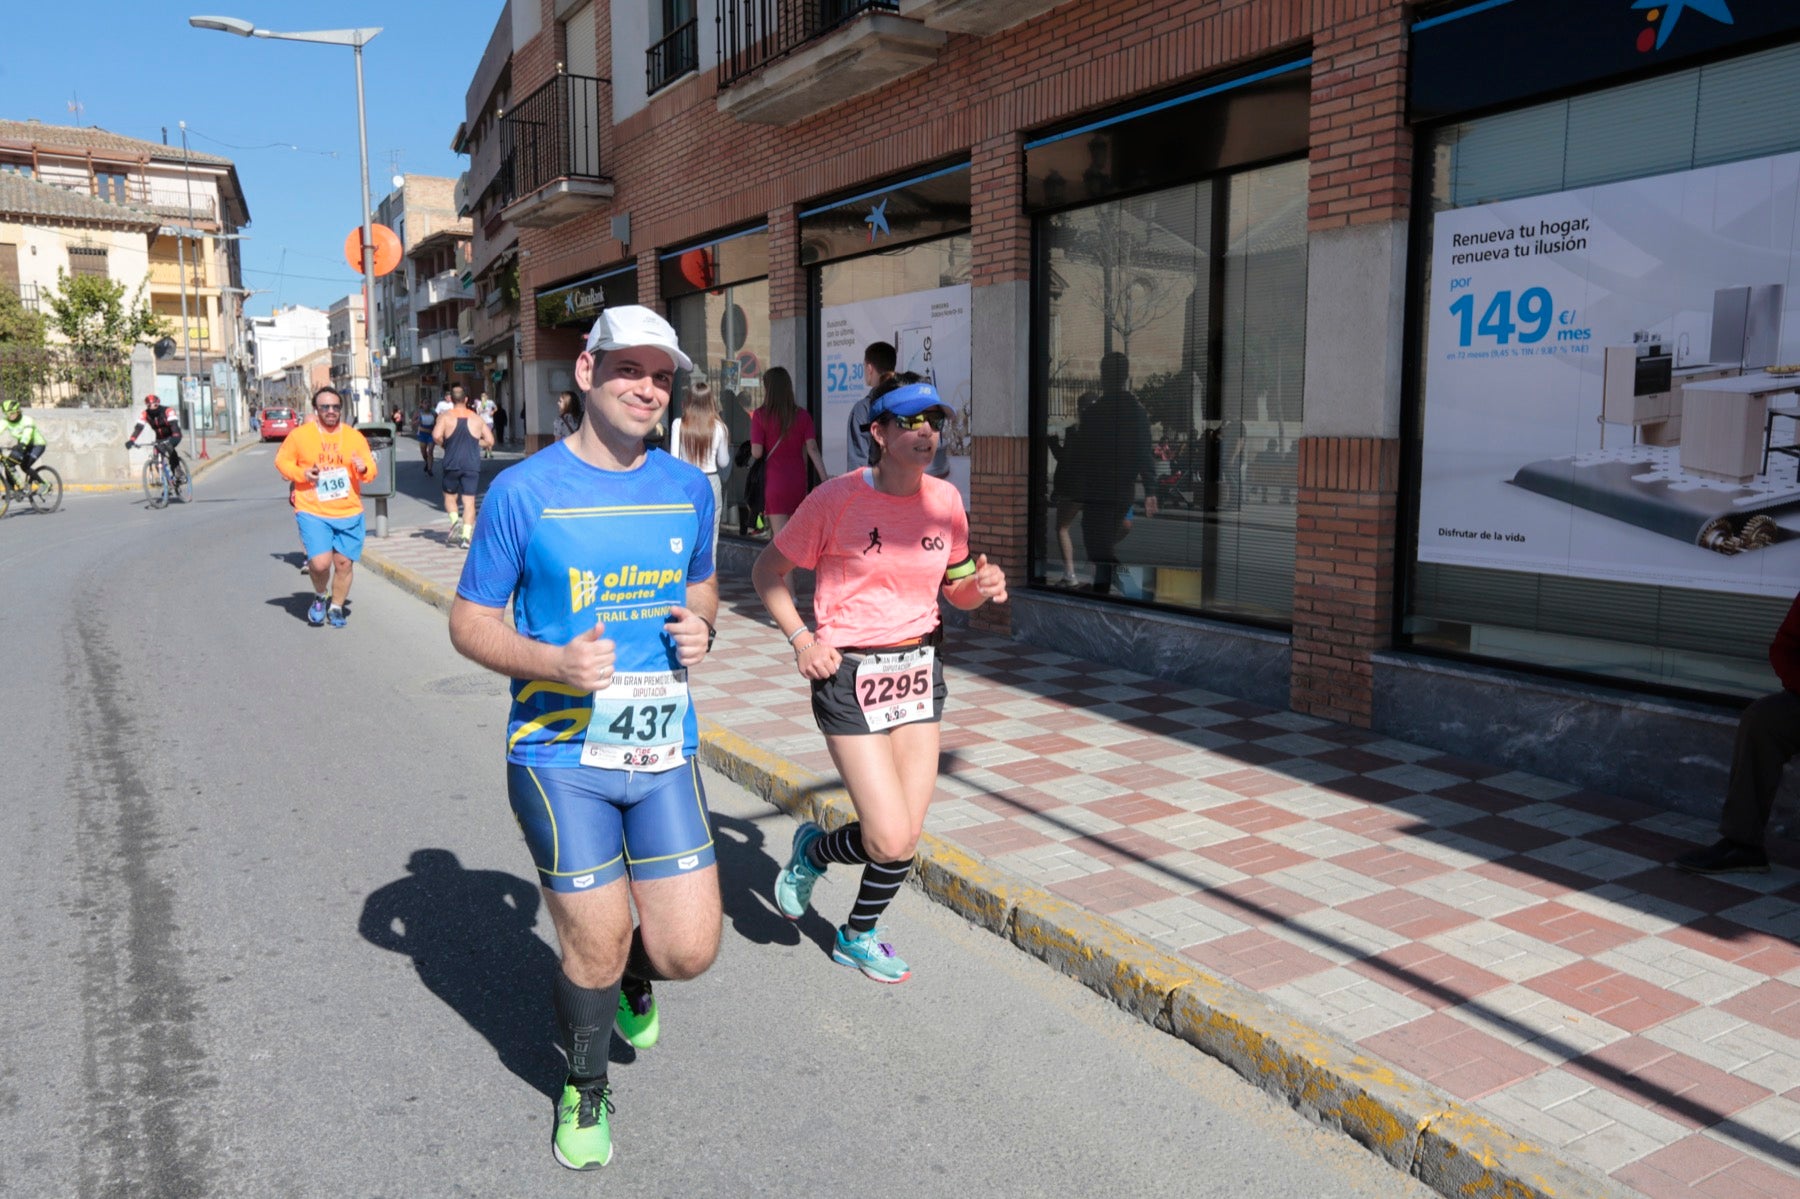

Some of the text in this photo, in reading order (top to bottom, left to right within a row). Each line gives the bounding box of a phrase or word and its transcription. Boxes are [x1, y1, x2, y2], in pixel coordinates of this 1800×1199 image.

[1453, 218, 1590, 247] Renueva tu hogar,
[1452, 236, 1587, 265] renueva tu ilusión
[1450, 276, 1472, 292] por
[1449, 286, 1553, 347] 149
[1558, 310, 1576, 325] €/
[1558, 328, 1591, 341] mes
[1522, 348, 1534, 356] TIN
[319, 454, 342, 464] RUN
[322, 478, 345, 492] 136
[1438, 528, 1526, 542] Disfrutar de la vida
[921, 536, 944, 551] GO
[604, 564, 682, 589] olimpo
[600, 590, 655, 604] deportes
[596, 612, 628, 622] TRAIL
[630, 610, 638, 620] &
[624, 676, 642, 686] GRAN
[860, 669, 928, 708] 2295
[608, 704, 677, 741] 437
